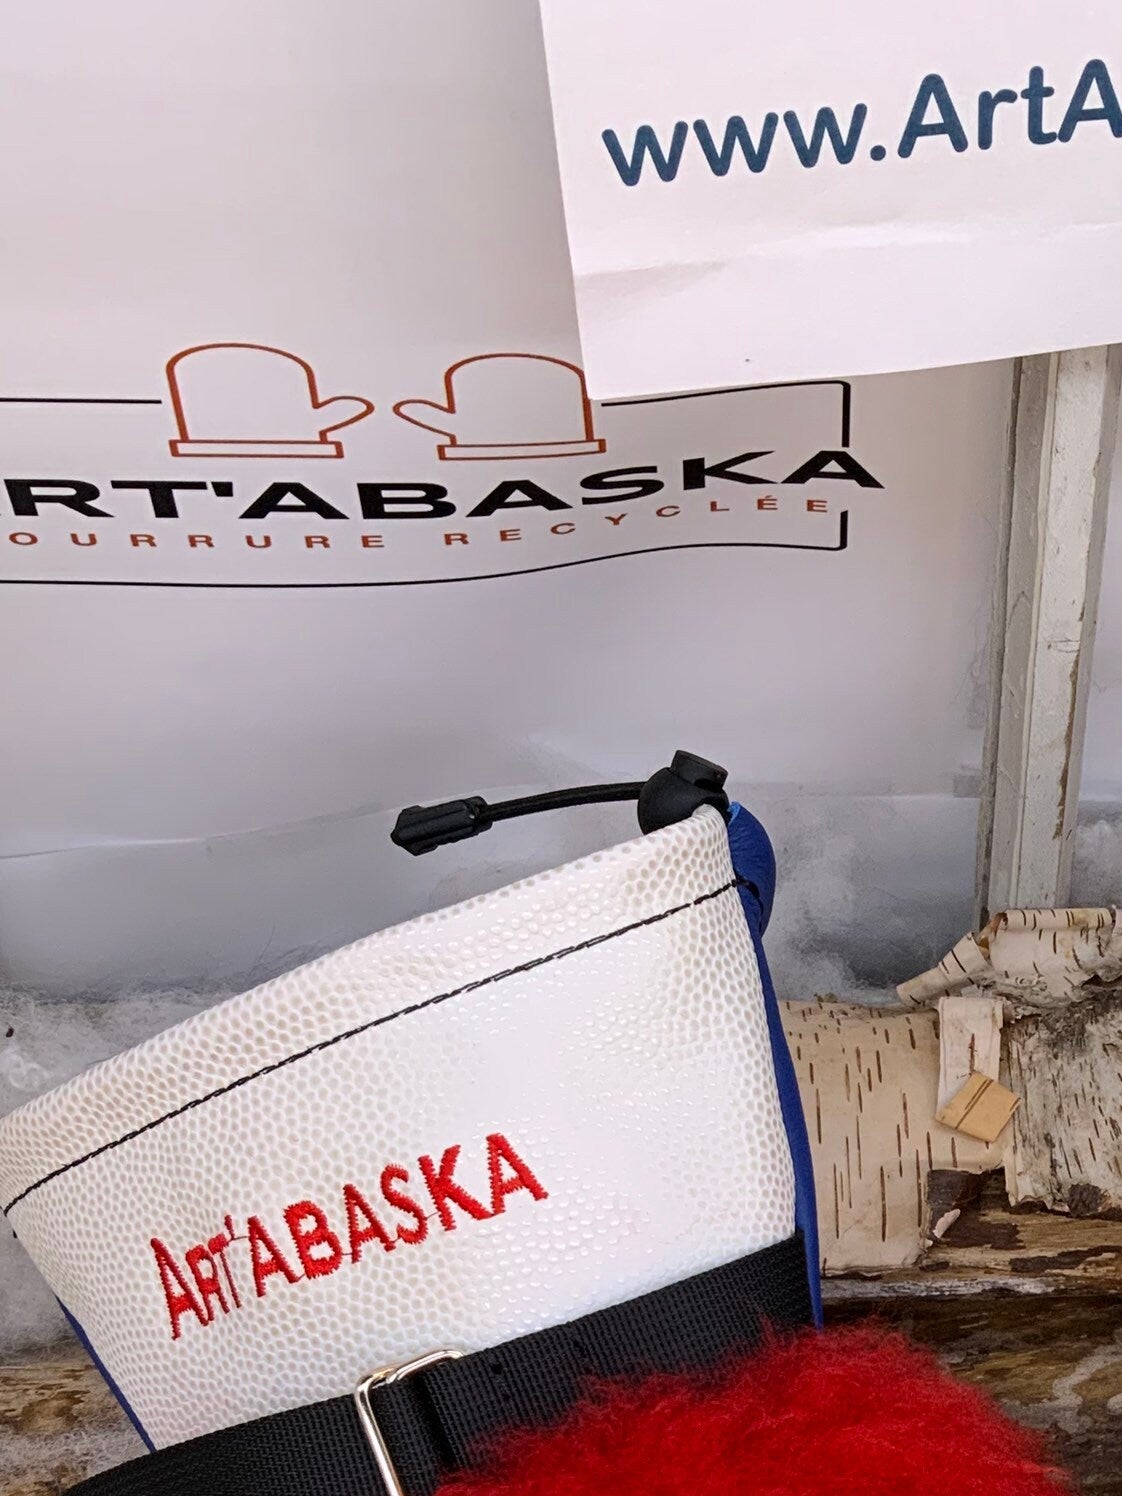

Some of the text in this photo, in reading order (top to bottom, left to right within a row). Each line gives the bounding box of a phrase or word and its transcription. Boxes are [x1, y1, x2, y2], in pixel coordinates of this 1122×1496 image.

[0, 450, 885, 520] RT'ABASKA
[7, 493, 830, 550] OURRURE RECYCLÉE
